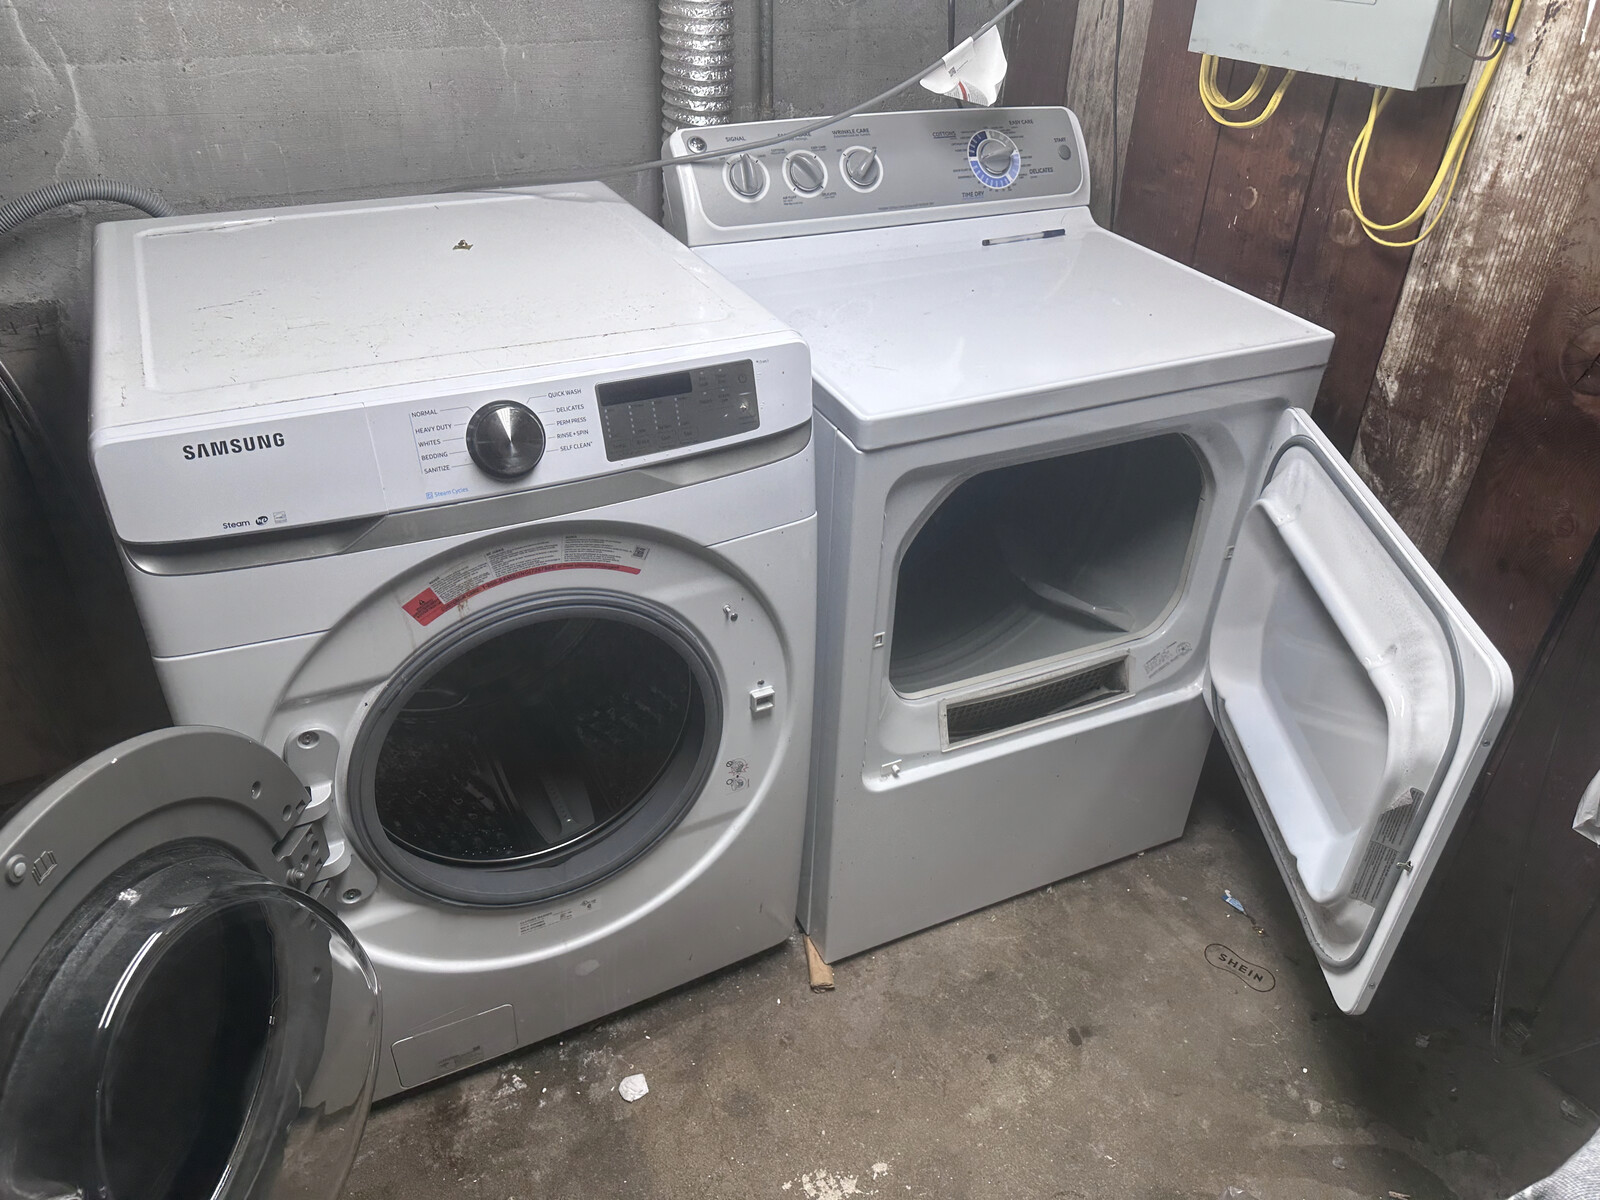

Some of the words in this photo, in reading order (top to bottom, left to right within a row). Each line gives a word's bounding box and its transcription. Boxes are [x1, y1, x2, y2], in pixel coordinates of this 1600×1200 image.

[548, 390, 565, 398] QUICK
[565, 388, 582, 396] WASH
[556, 403, 585, 413] DELICATES
[411, 409, 438, 418] NORMAL
[571, 416, 587, 424] PRESS
[415, 426, 435, 434] HEAVY
[436, 423, 452, 431] DUTY
[557, 431, 572, 439] RINSE
[182, 432, 285, 460] SAMSUNG
[418, 438, 441, 448] WHITES
[560, 444, 572, 452] SELF
[421, 451, 448, 461] BEDDING
[424, 464, 450, 475] SANITIZE
[434, 489, 451, 498] Steam
[451, 486, 469, 496] Cycles
[222, 520, 250, 529] Steam
[1218, 953, 1264, 982] SHEIN
